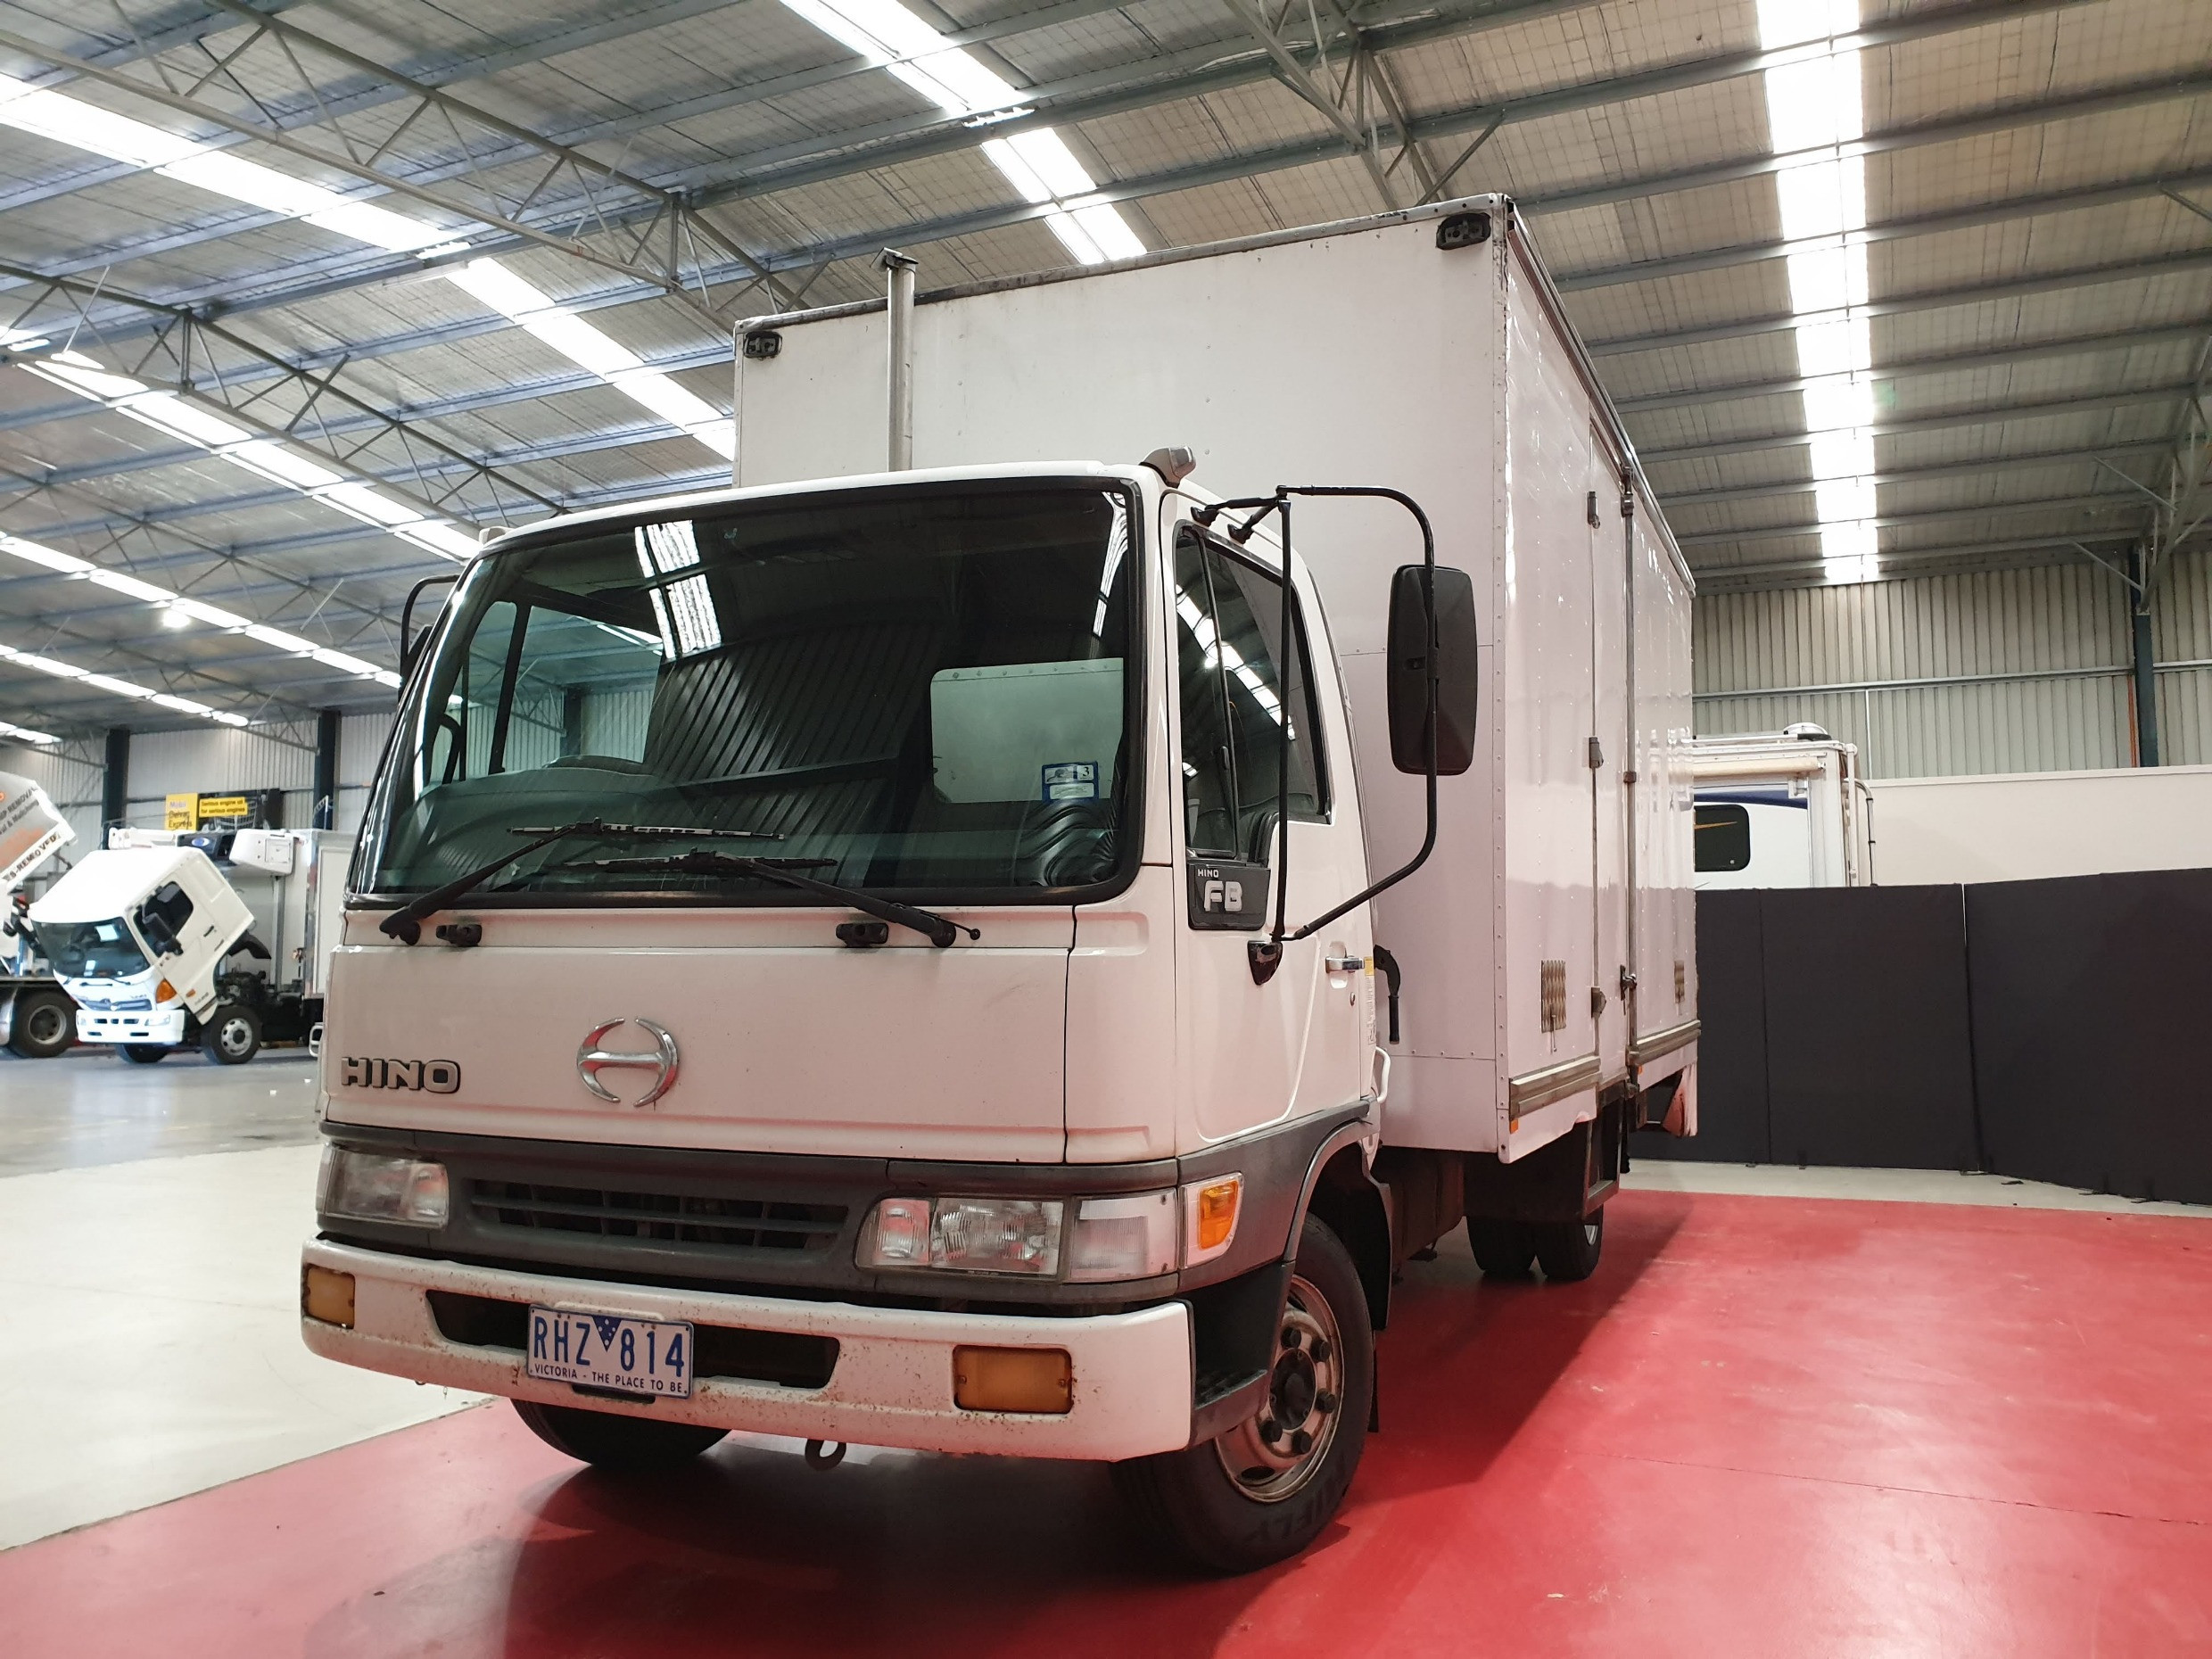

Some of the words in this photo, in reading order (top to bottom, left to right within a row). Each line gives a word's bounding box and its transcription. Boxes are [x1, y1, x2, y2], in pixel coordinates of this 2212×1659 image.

[1082, 766, 1090, 777] 3
[1197, 869, 1219, 879] HINO
[1203, 879, 1243, 912] FB
[341, 1056, 461, 1094] HINO
[534, 1316, 591, 1366] RHZ
[620, 1327, 685, 1378] 814
[534, 1362, 578, 1380] VICTORIA
[592, 1370, 610, 1384] THE
[615, 1374, 645, 1390] PLACE
[650, 1378, 664, 1391] TO
